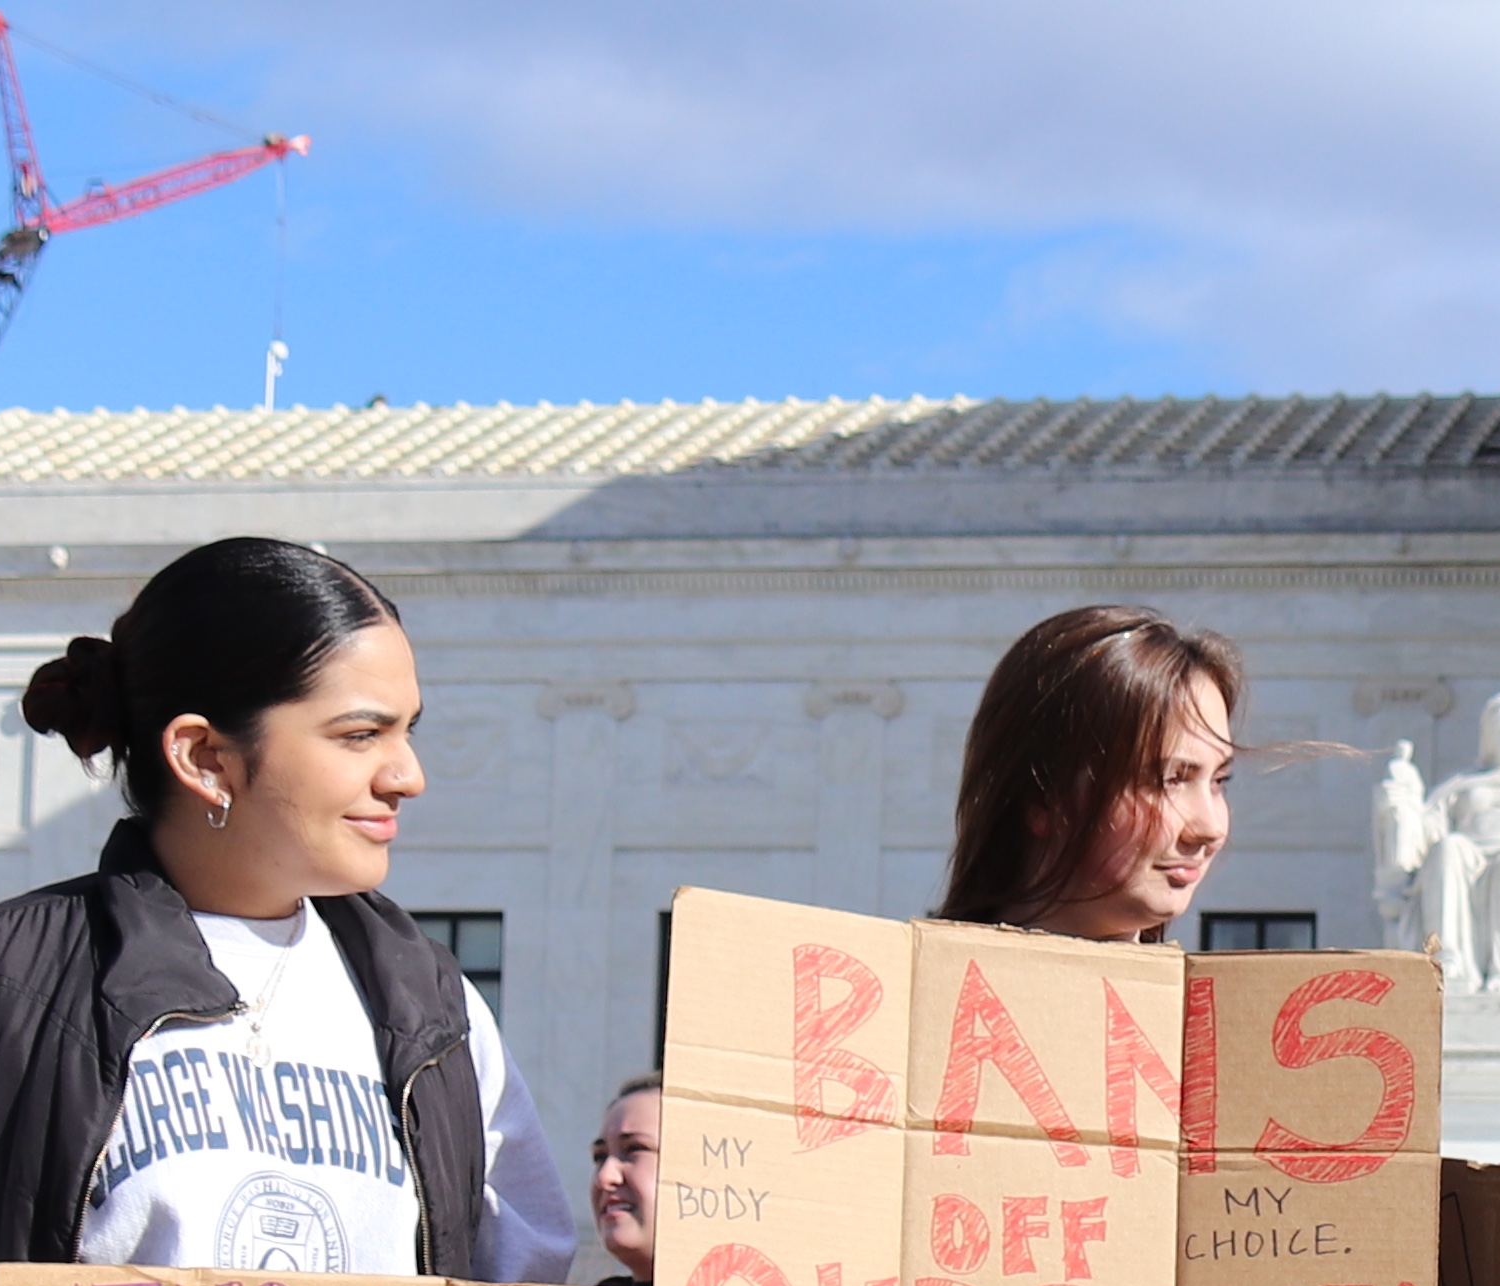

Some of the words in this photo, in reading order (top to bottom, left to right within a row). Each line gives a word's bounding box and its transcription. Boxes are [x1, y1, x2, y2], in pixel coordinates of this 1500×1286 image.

[792, 941, 1416, 1184] BANS
[90, 1048, 229, 1210] ORGE
[700, 1133, 754, 1169] MY
[676, 1183, 771, 1223] BODY
[1223, 1186, 1296, 1216] MY
[930, 1192, 1109, 1281] OFF
[1184, 1222, 1354, 1261] CHOICE.
